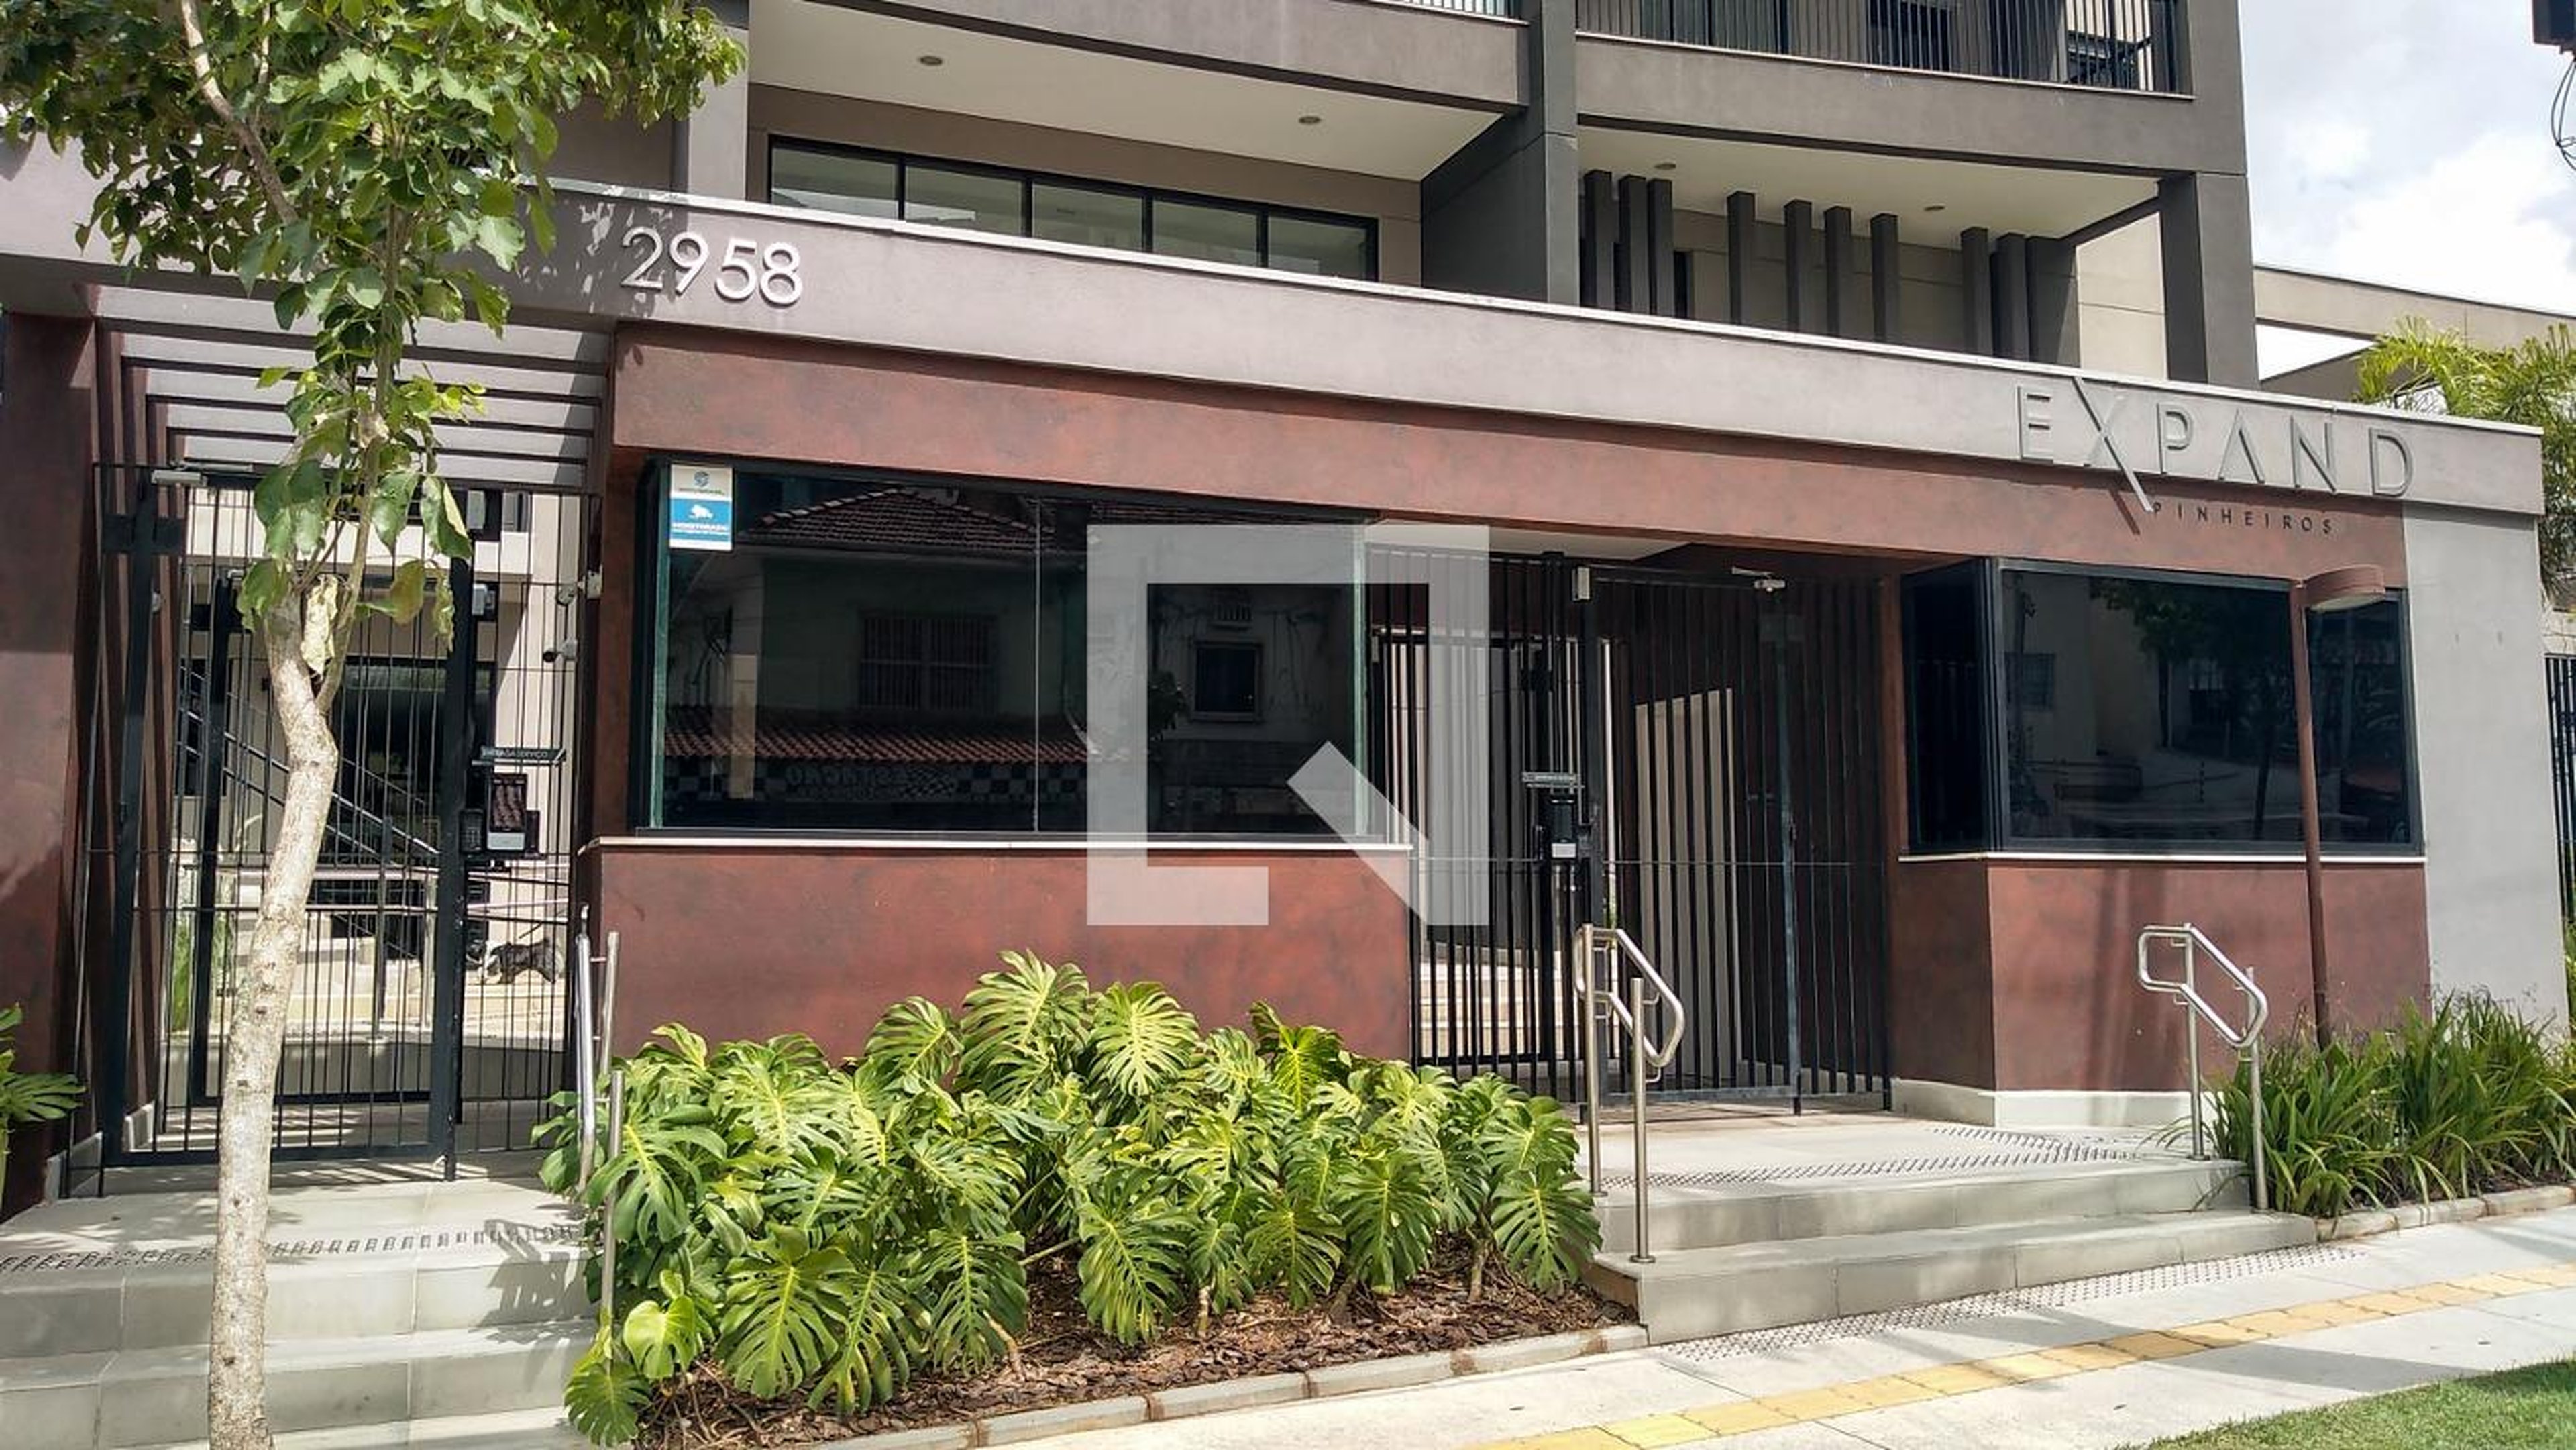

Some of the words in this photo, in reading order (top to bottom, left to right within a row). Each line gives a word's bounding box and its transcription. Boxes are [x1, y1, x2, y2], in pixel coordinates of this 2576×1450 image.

[620, 226, 804, 306] 2958
[2016, 376, 2416, 512] EXPAND
[2153, 501, 2333, 535] PINHEIROS
